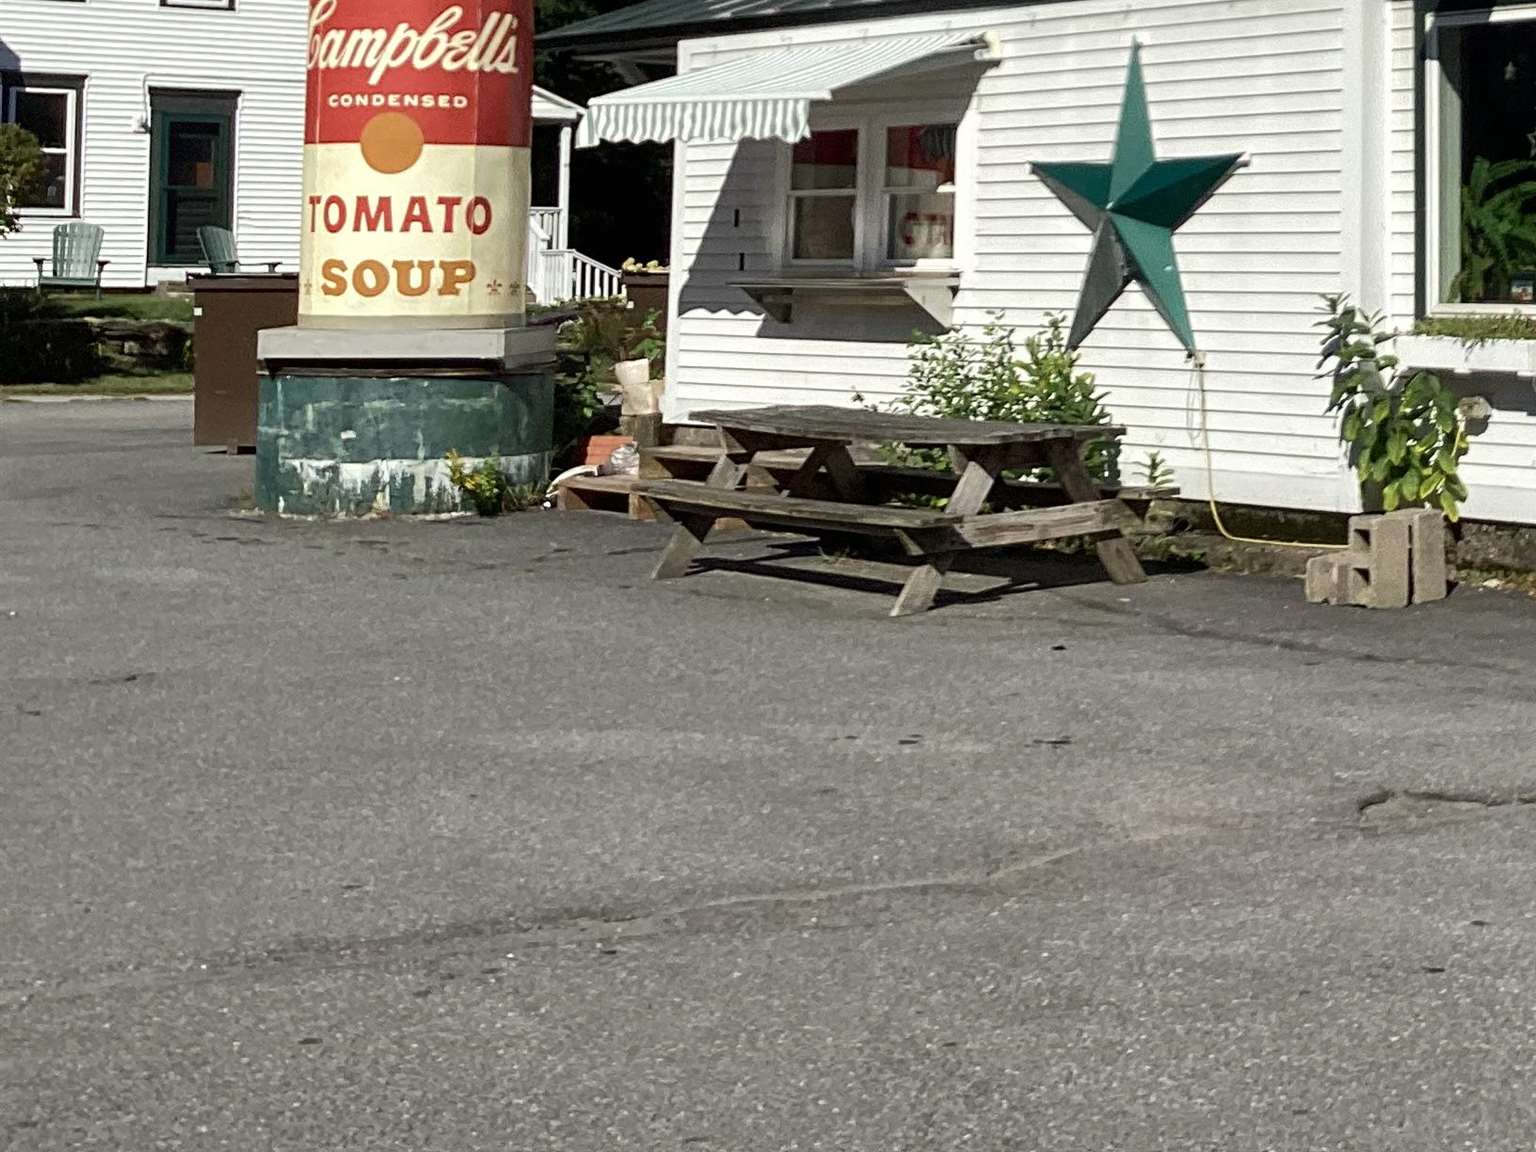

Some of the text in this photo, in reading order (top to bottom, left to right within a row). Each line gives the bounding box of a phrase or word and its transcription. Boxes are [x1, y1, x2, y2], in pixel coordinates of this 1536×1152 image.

[328, 93, 469, 109] CONDENSED
[308, 194, 493, 236] TOMATO
[320, 257, 477, 299] SOUP
